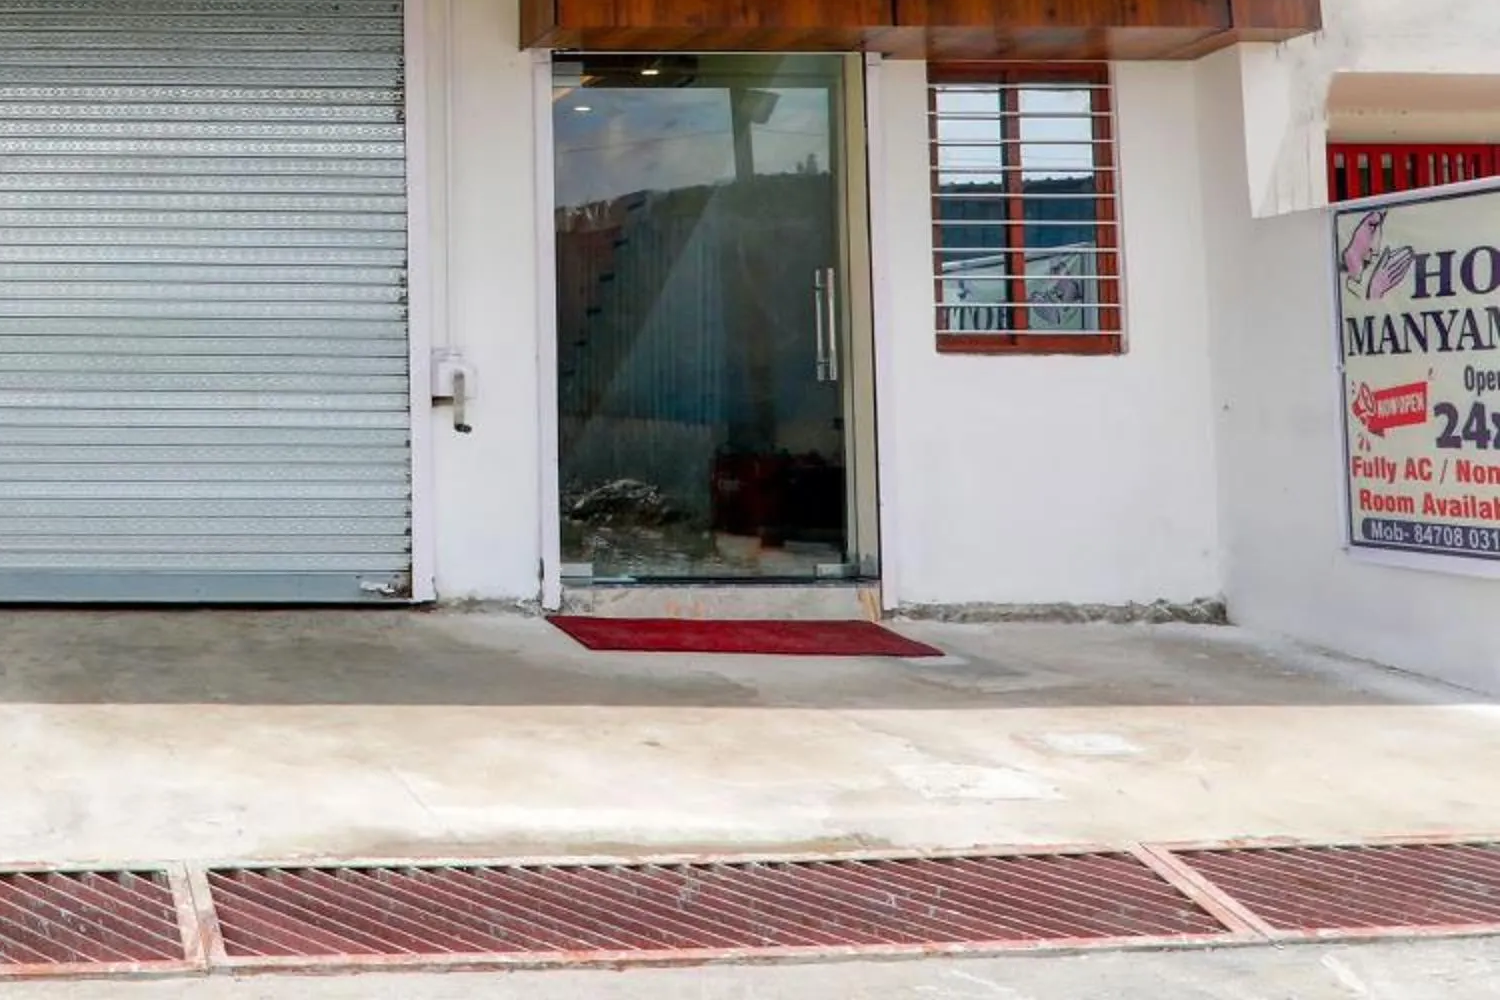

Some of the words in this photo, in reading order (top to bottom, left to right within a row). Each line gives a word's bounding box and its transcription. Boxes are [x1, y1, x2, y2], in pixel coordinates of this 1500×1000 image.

[1410, 245, 1500, 299] HO
[1352, 456, 1397, 484] Fully
[1405, 457, 1432, 481] AC
[1360, 488, 1414, 513] Room
[1414, 524, 1463, 546] 84708
[1469, 529, 1500, 550] 031
